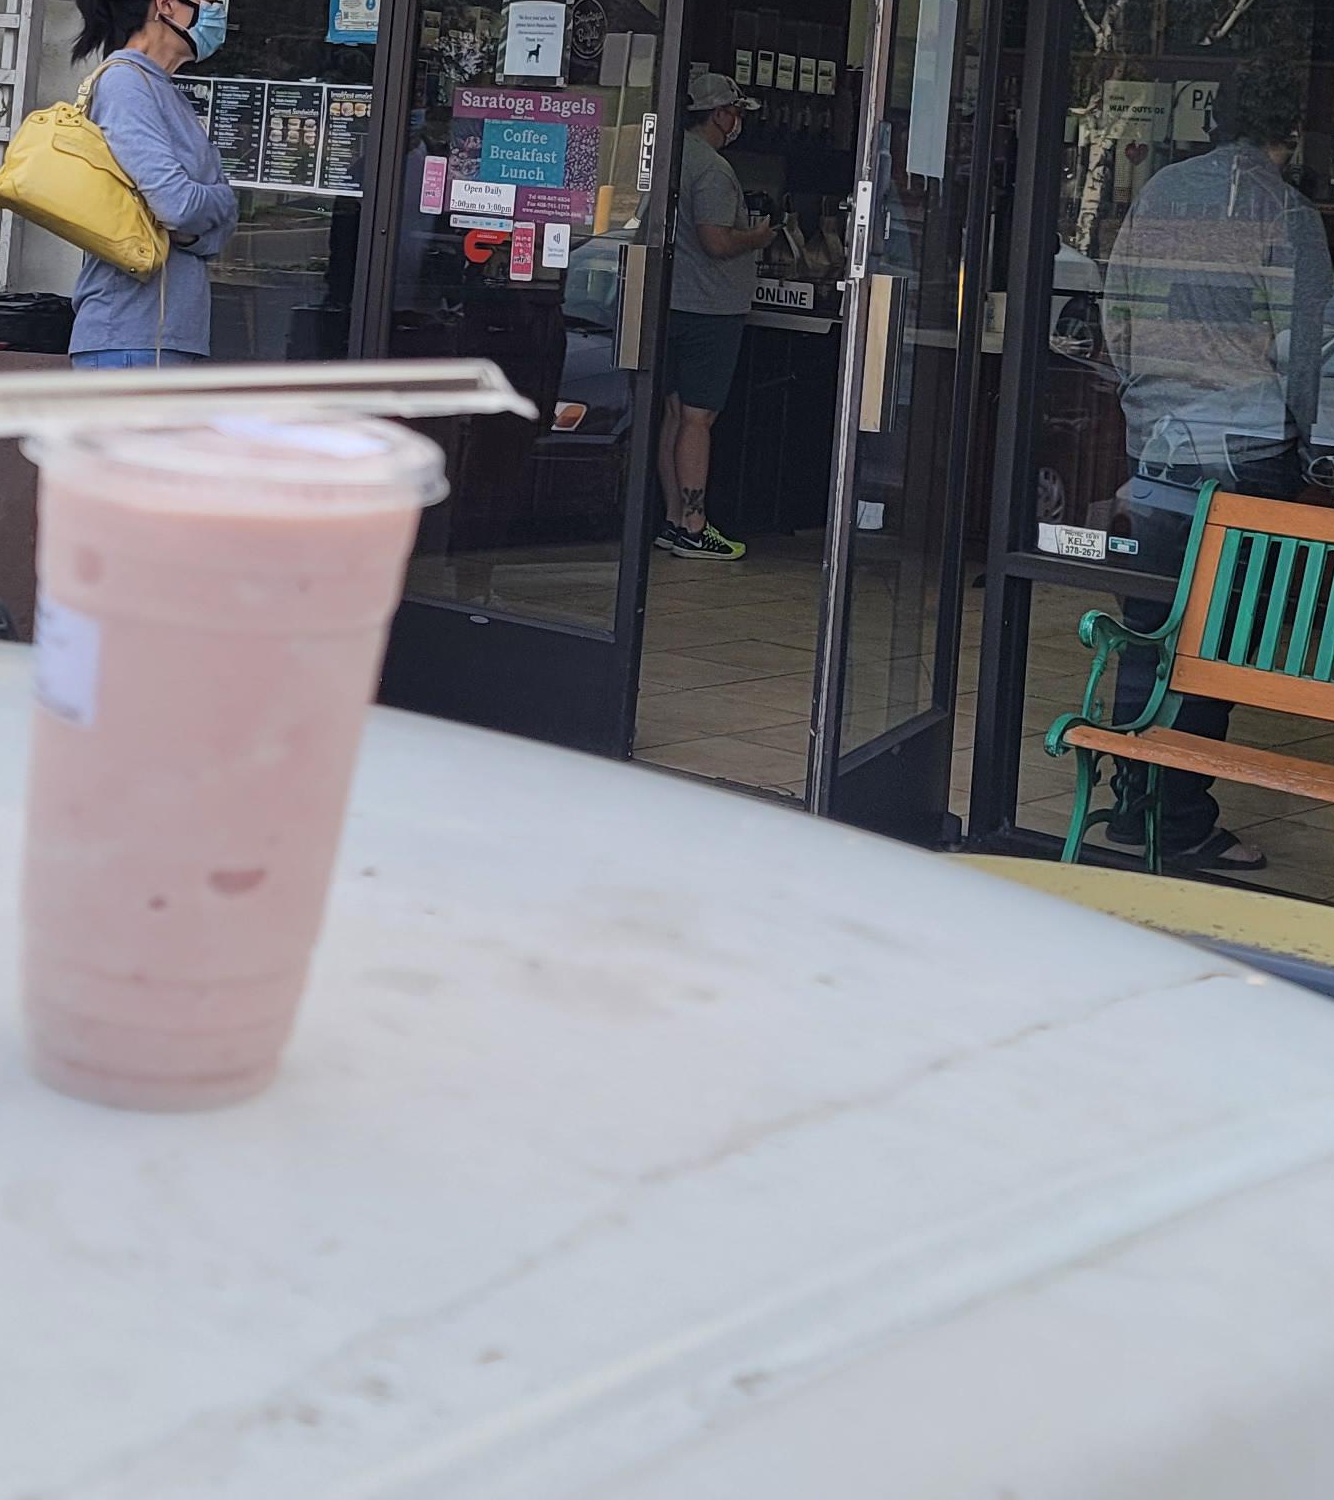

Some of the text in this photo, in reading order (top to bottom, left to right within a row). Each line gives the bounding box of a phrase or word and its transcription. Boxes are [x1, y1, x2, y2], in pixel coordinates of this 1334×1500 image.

[461, 90, 596, 117] Saratoga Bagels
[503, 128, 548, 145] Coffee
[490, 145, 558, 164] Breakfast
[641, 120, 655, 173] PULL
[500, 165, 545, 181] Lunch
[464, 184, 502, 196] Open Daily
[451, 199, 512, 214] 7:00am to 3:00pm
[755, 285, 808, 307] ONLINE
